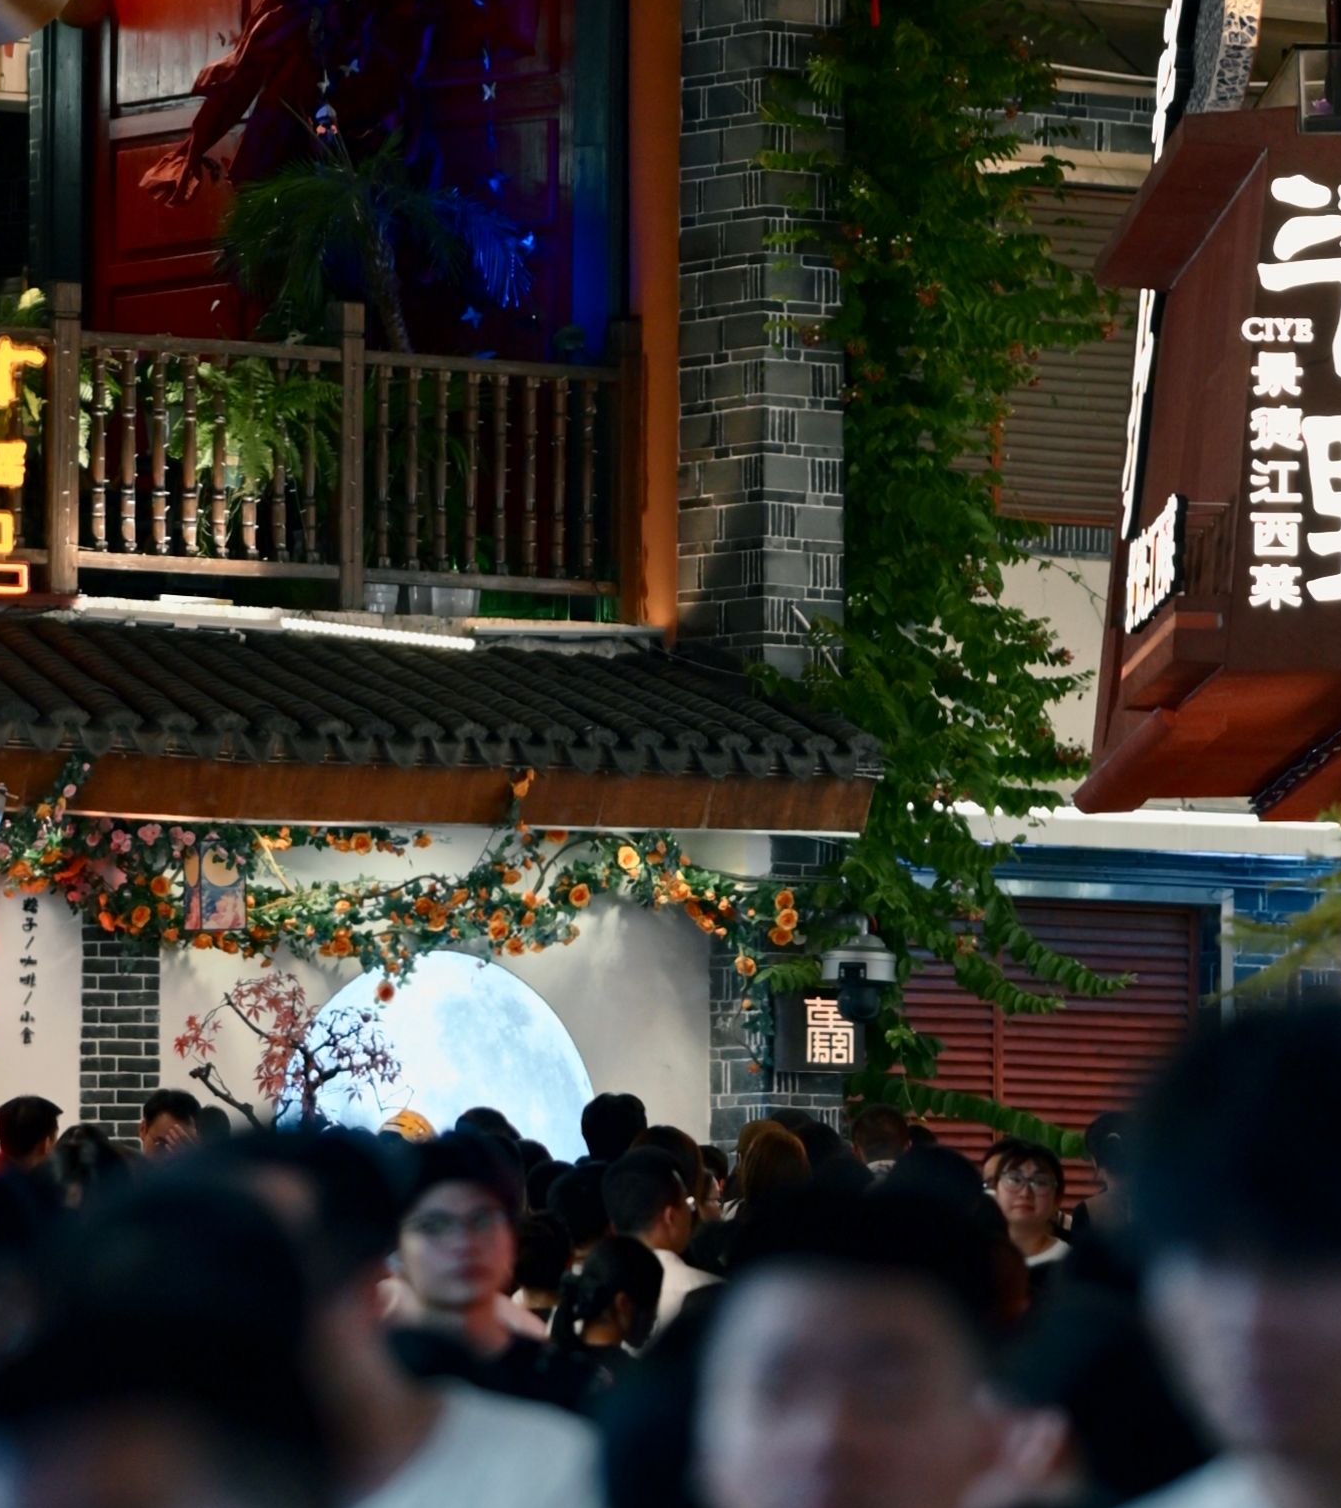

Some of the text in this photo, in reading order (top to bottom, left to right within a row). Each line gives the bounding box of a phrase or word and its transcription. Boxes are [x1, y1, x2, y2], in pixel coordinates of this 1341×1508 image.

[1241, 317, 1314, 344] CIYE
[1249, 351, 1305, 611] 景德江西菜
